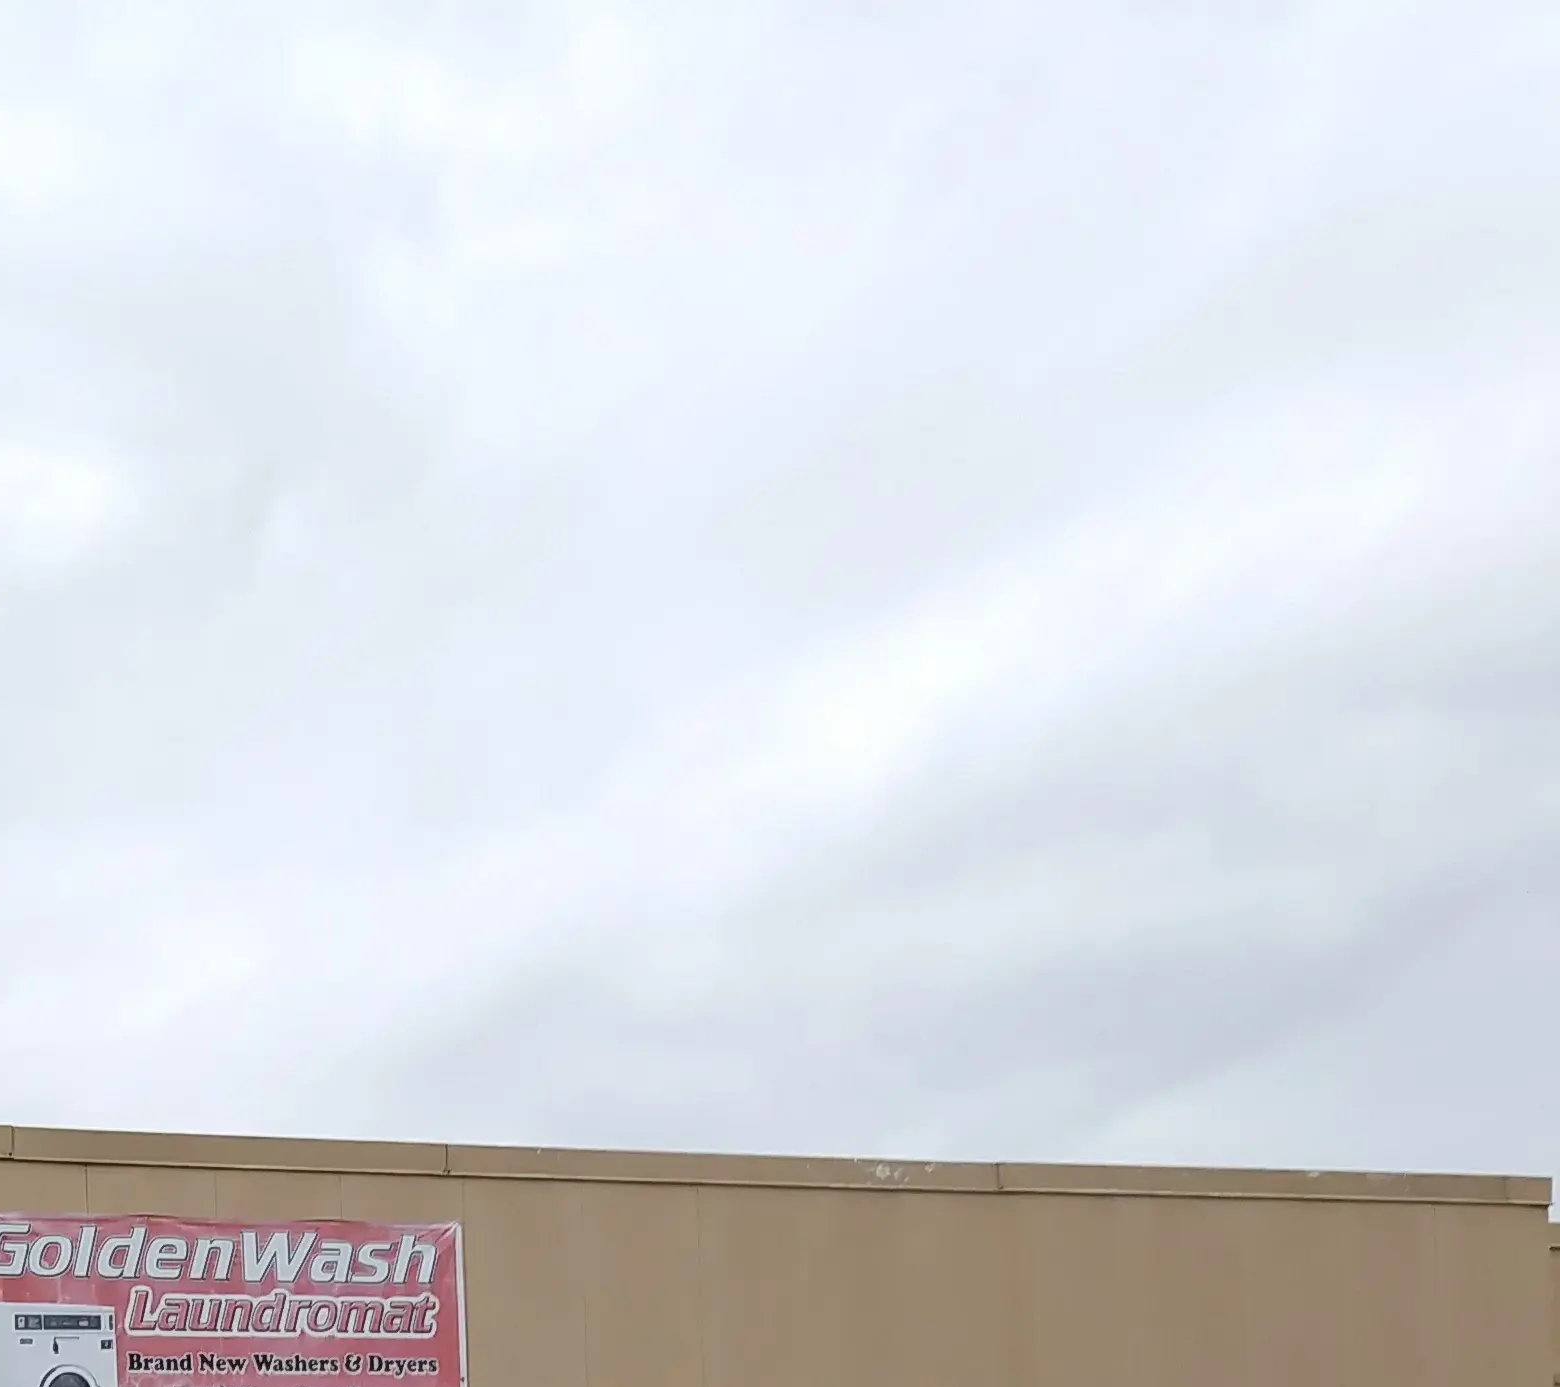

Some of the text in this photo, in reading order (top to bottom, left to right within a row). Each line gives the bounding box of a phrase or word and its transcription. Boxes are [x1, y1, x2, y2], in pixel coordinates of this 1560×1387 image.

[126, 1287, 438, 1337] Laundromat
[128, 1353, 437, 1376] Brand New Washers & Dryers
